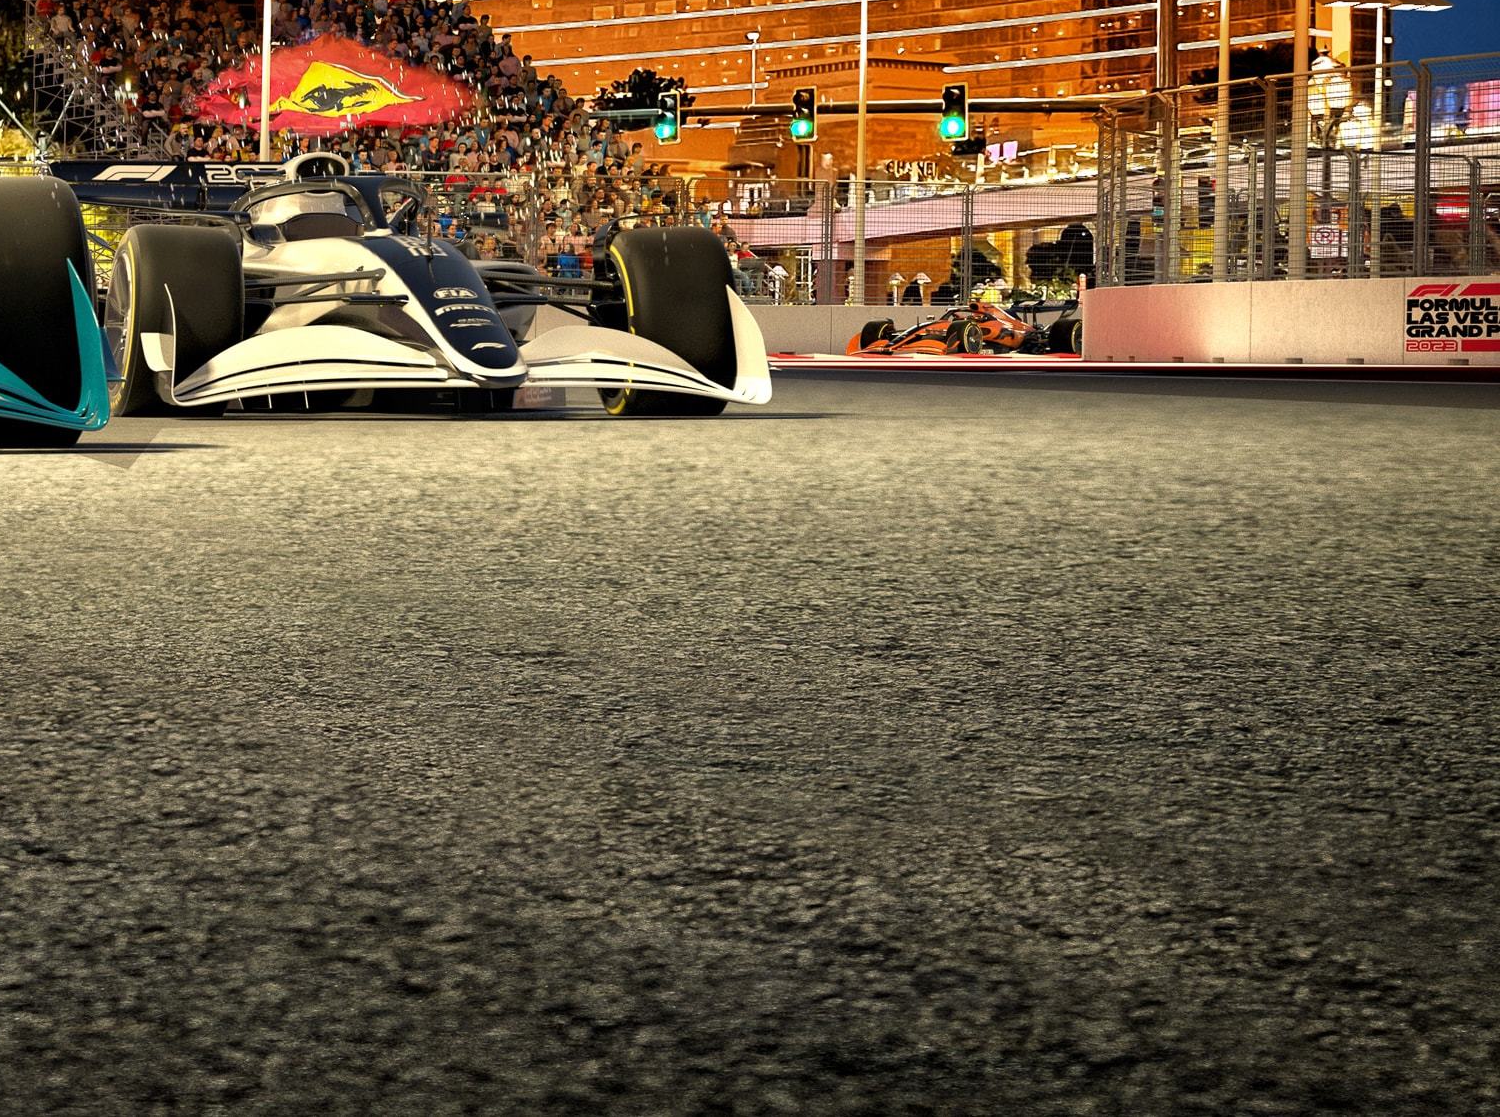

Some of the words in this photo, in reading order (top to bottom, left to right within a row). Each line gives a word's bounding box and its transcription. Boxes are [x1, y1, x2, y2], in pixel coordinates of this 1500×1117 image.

[1406, 298, 1500, 312] FORMUL
[1406, 312, 1450, 325] LAS
[1453, 312, 1500, 325] VEG
[1406, 325, 1484, 338] GRAND
[1406, 339, 1458, 352] 2023
